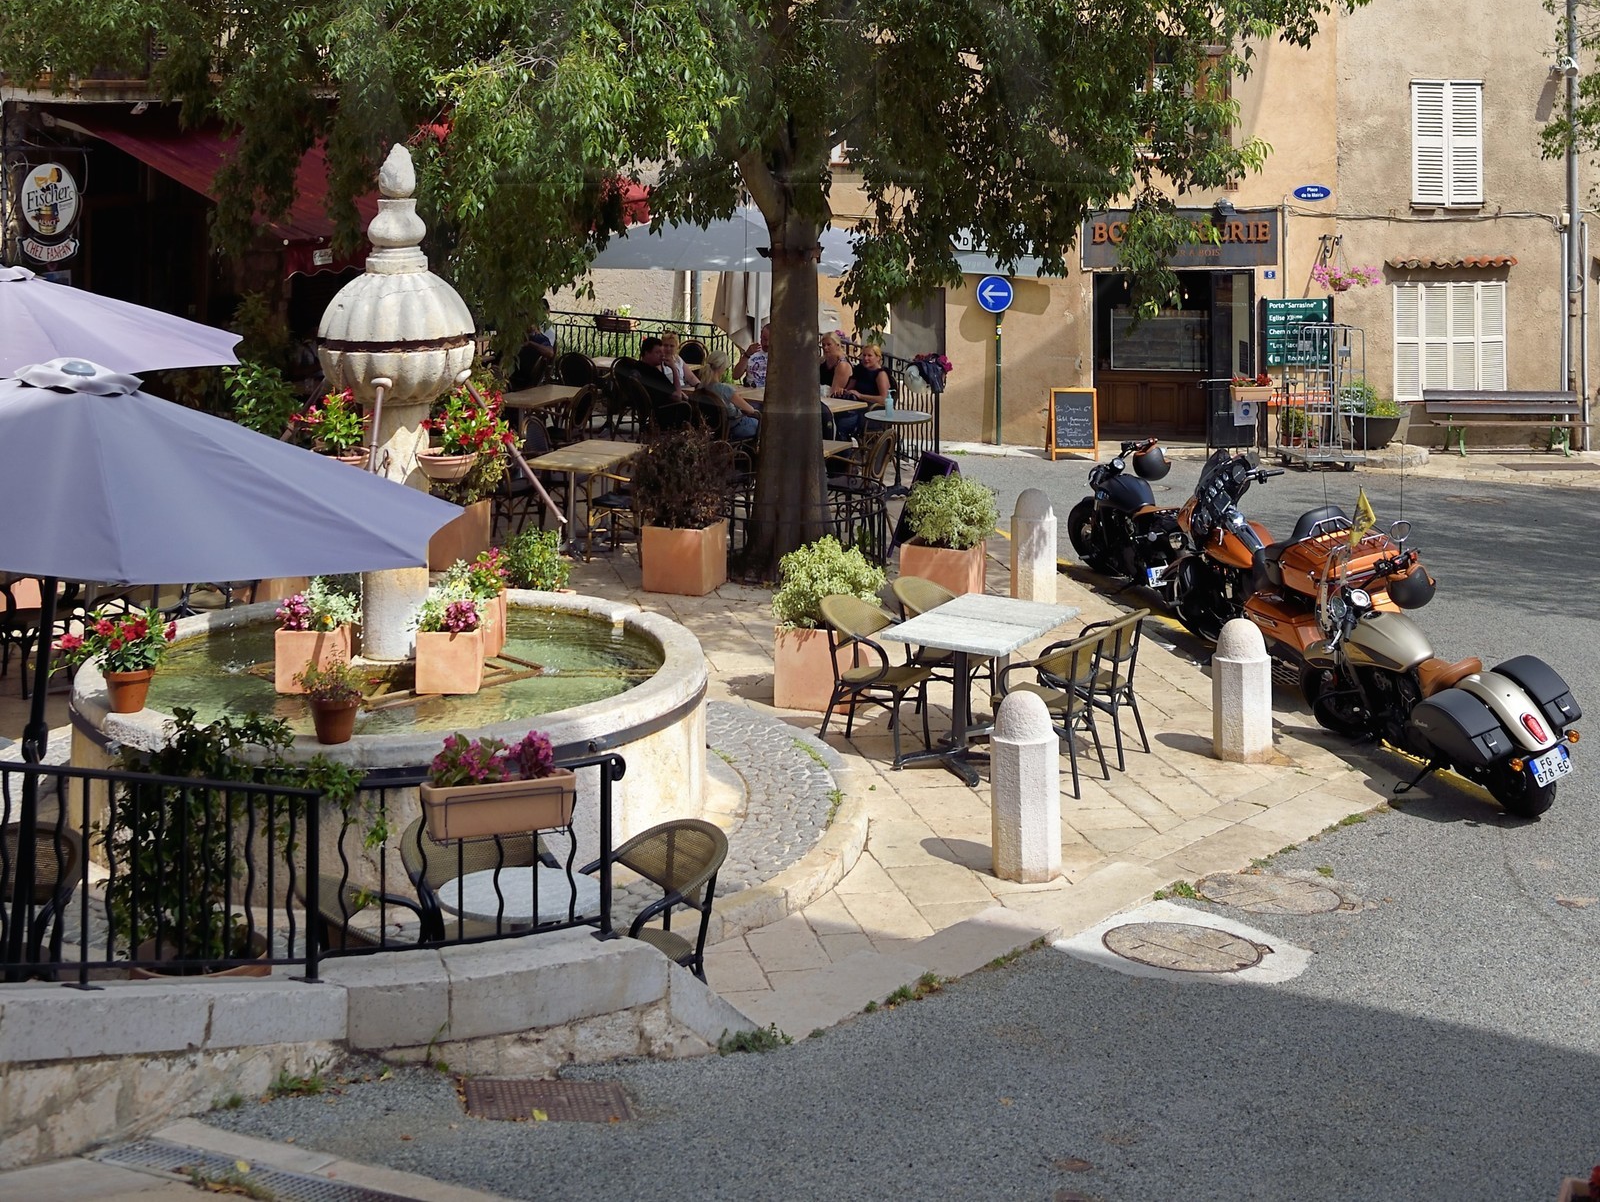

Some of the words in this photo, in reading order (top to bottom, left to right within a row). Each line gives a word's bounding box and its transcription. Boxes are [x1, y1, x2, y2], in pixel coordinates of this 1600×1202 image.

[27, 183, 70, 210] Fischer
[26, 240, 44, 258] CHEZ
[1537, 760, 1570, 783] 678-EC
